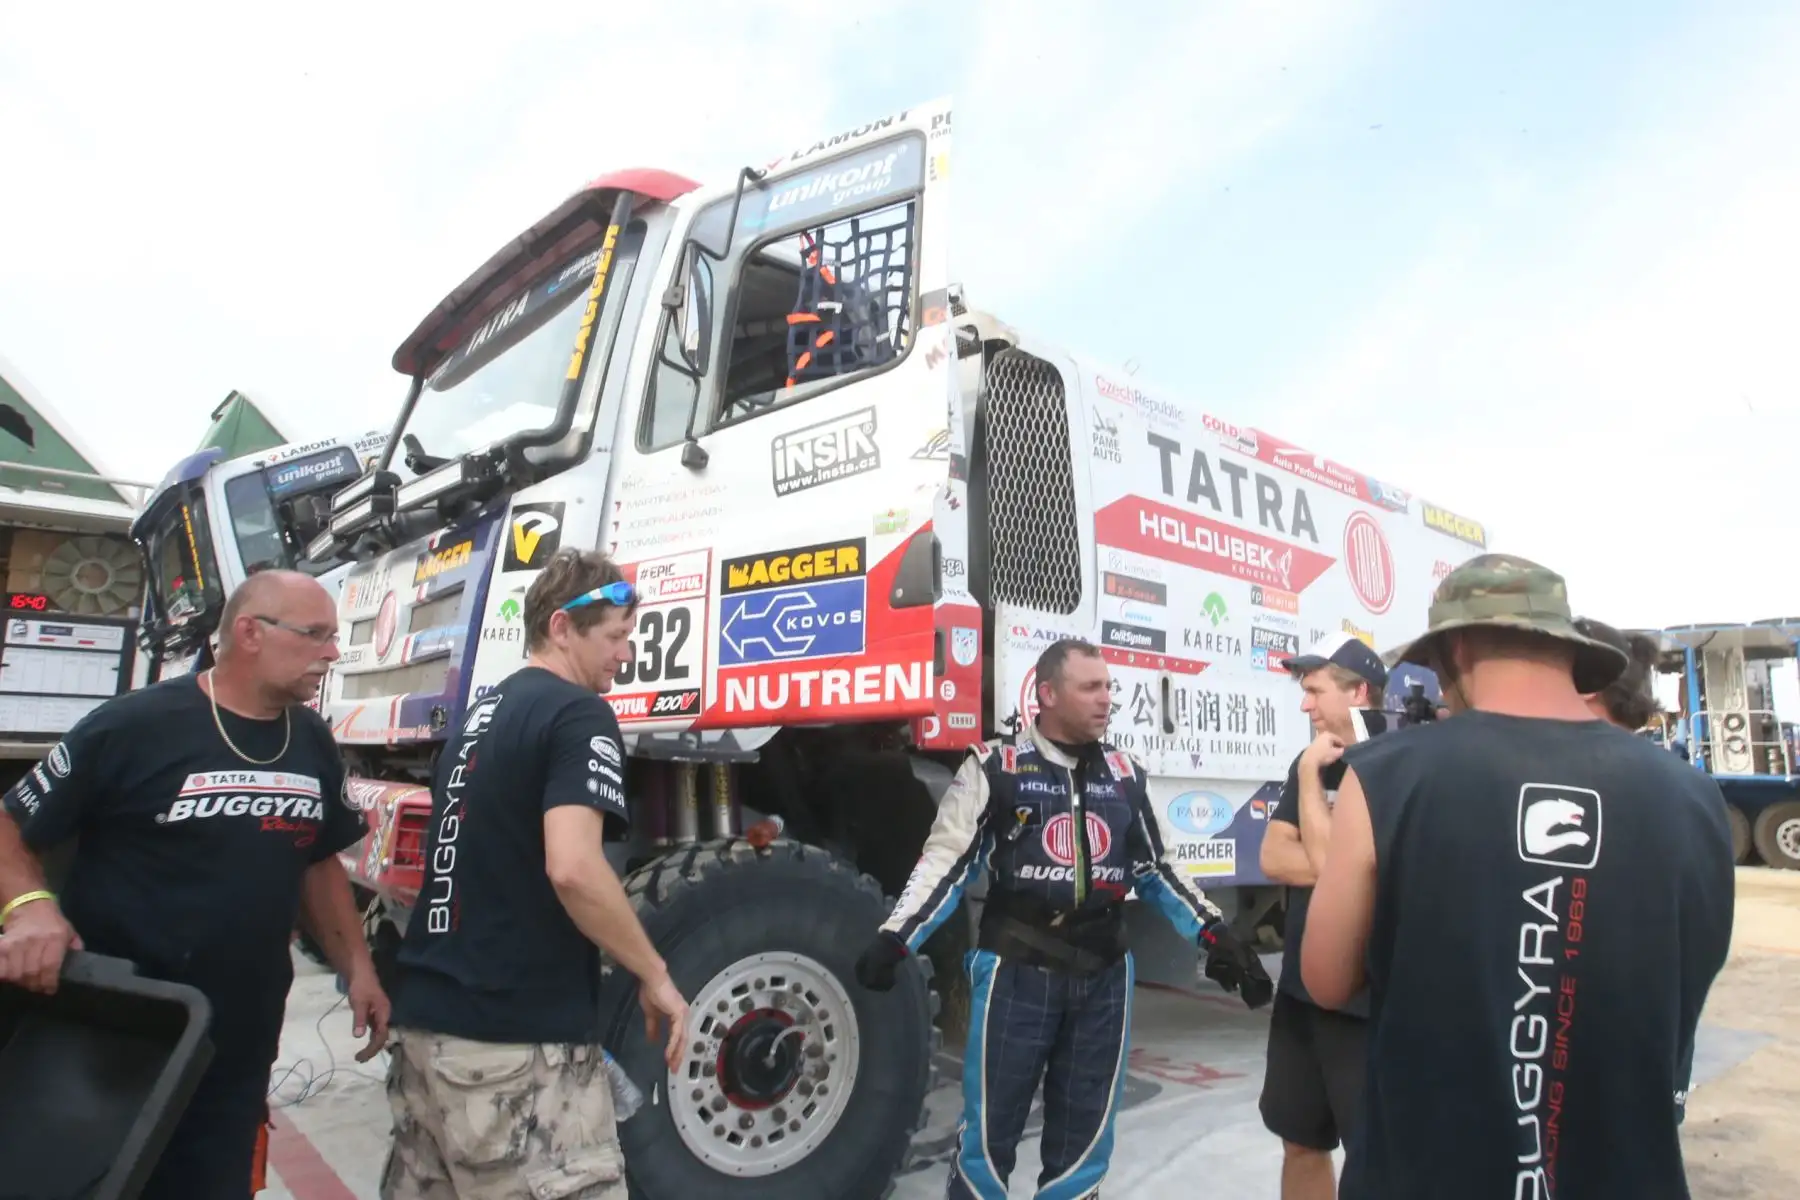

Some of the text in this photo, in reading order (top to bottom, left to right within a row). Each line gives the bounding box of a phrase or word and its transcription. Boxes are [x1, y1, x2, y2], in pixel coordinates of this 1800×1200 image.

[790, 109, 911, 162] LAMONT
[768, 151, 897, 213] unikont
[832, 175, 891, 206] group
[281, 437, 337, 459] LAMONT
[277, 455, 342, 484] unikont
[316, 466, 345, 482] group
[777, 457, 877, 493] www.insta.cz
[1147, 430, 1319, 543] TATRA
[1139, 509, 1275, 570] HOLOUBEK
[662, 574, 703, 595] MOTUL
[786, 609, 862, 630] KOVOS
[1184, 627, 1242, 657] KARETA
[653, 692, 698, 712] 300V
[1210, 739, 1276, 757] LUBRICANT
[211, 774, 257, 785] TATRA
[167, 796, 324, 823] BUGGYRA
[428, 740, 478, 934] BUGGYRA
[1552, 974, 1577, 1071] SINCE
[1510, 876, 1564, 1200] BUGGYRA
